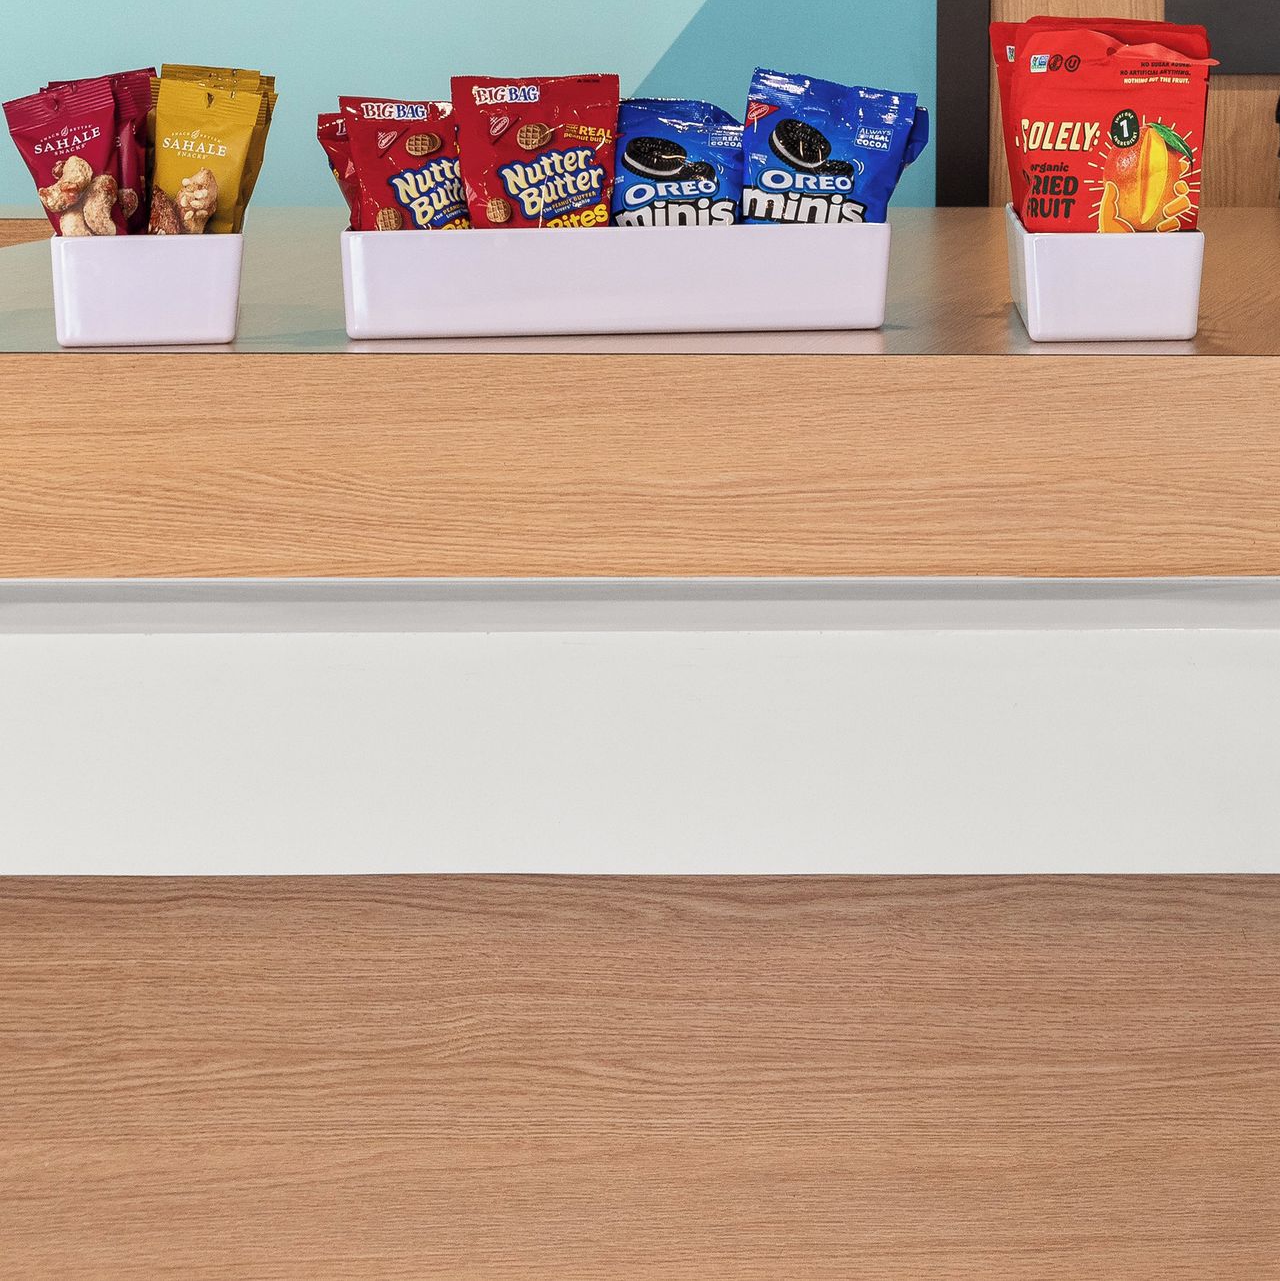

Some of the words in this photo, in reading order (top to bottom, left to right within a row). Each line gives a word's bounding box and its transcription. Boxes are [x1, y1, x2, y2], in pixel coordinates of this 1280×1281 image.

[475, 86, 506, 104] BIG
[507, 85, 539, 102] BAG
[361, 103, 394, 119] BIG
[395, 104, 427, 119] BAG
[579, 125, 612, 139] REAL
[1120, 119, 1129, 137] 1
[34, 126, 101, 155] SAHALE
[54, 143, 86, 156] SNACKS
[162, 137, 227, 157] SAHALE
[856, 139, 888, 150] COCOA
[177, 150, 205, 159] SNACKS
[502, 149, 591, 194] Nutter
[760, 170, 853, 191] OREO
[519, 167, 604, 216] Butter
[624, 180, 717, 206] OREO
[1024, 173, 1079, 196] RIED
[616, 198, 737, 227] minis
[743, 187, 864, 224] minis
